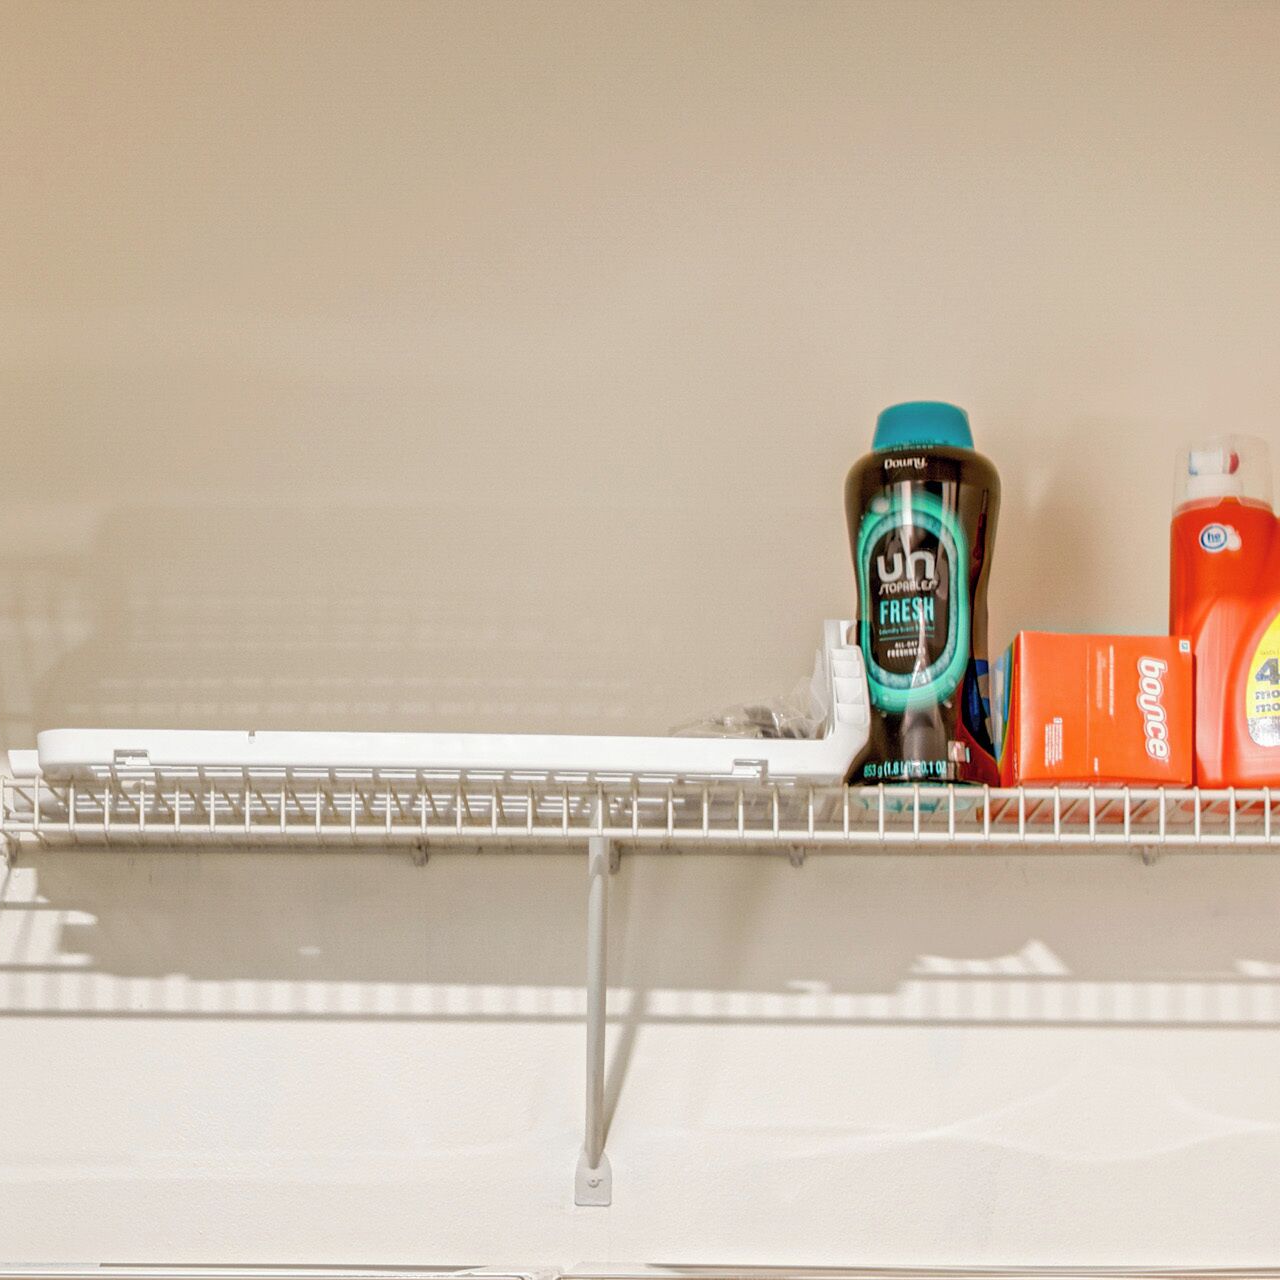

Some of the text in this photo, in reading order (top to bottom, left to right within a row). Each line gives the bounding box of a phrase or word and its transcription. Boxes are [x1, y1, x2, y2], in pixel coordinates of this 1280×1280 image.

[884, 457, 926, 469] Downy
[880, 597, 934, 624] FRESH
[1138, 657, 1169, 760] bounce
